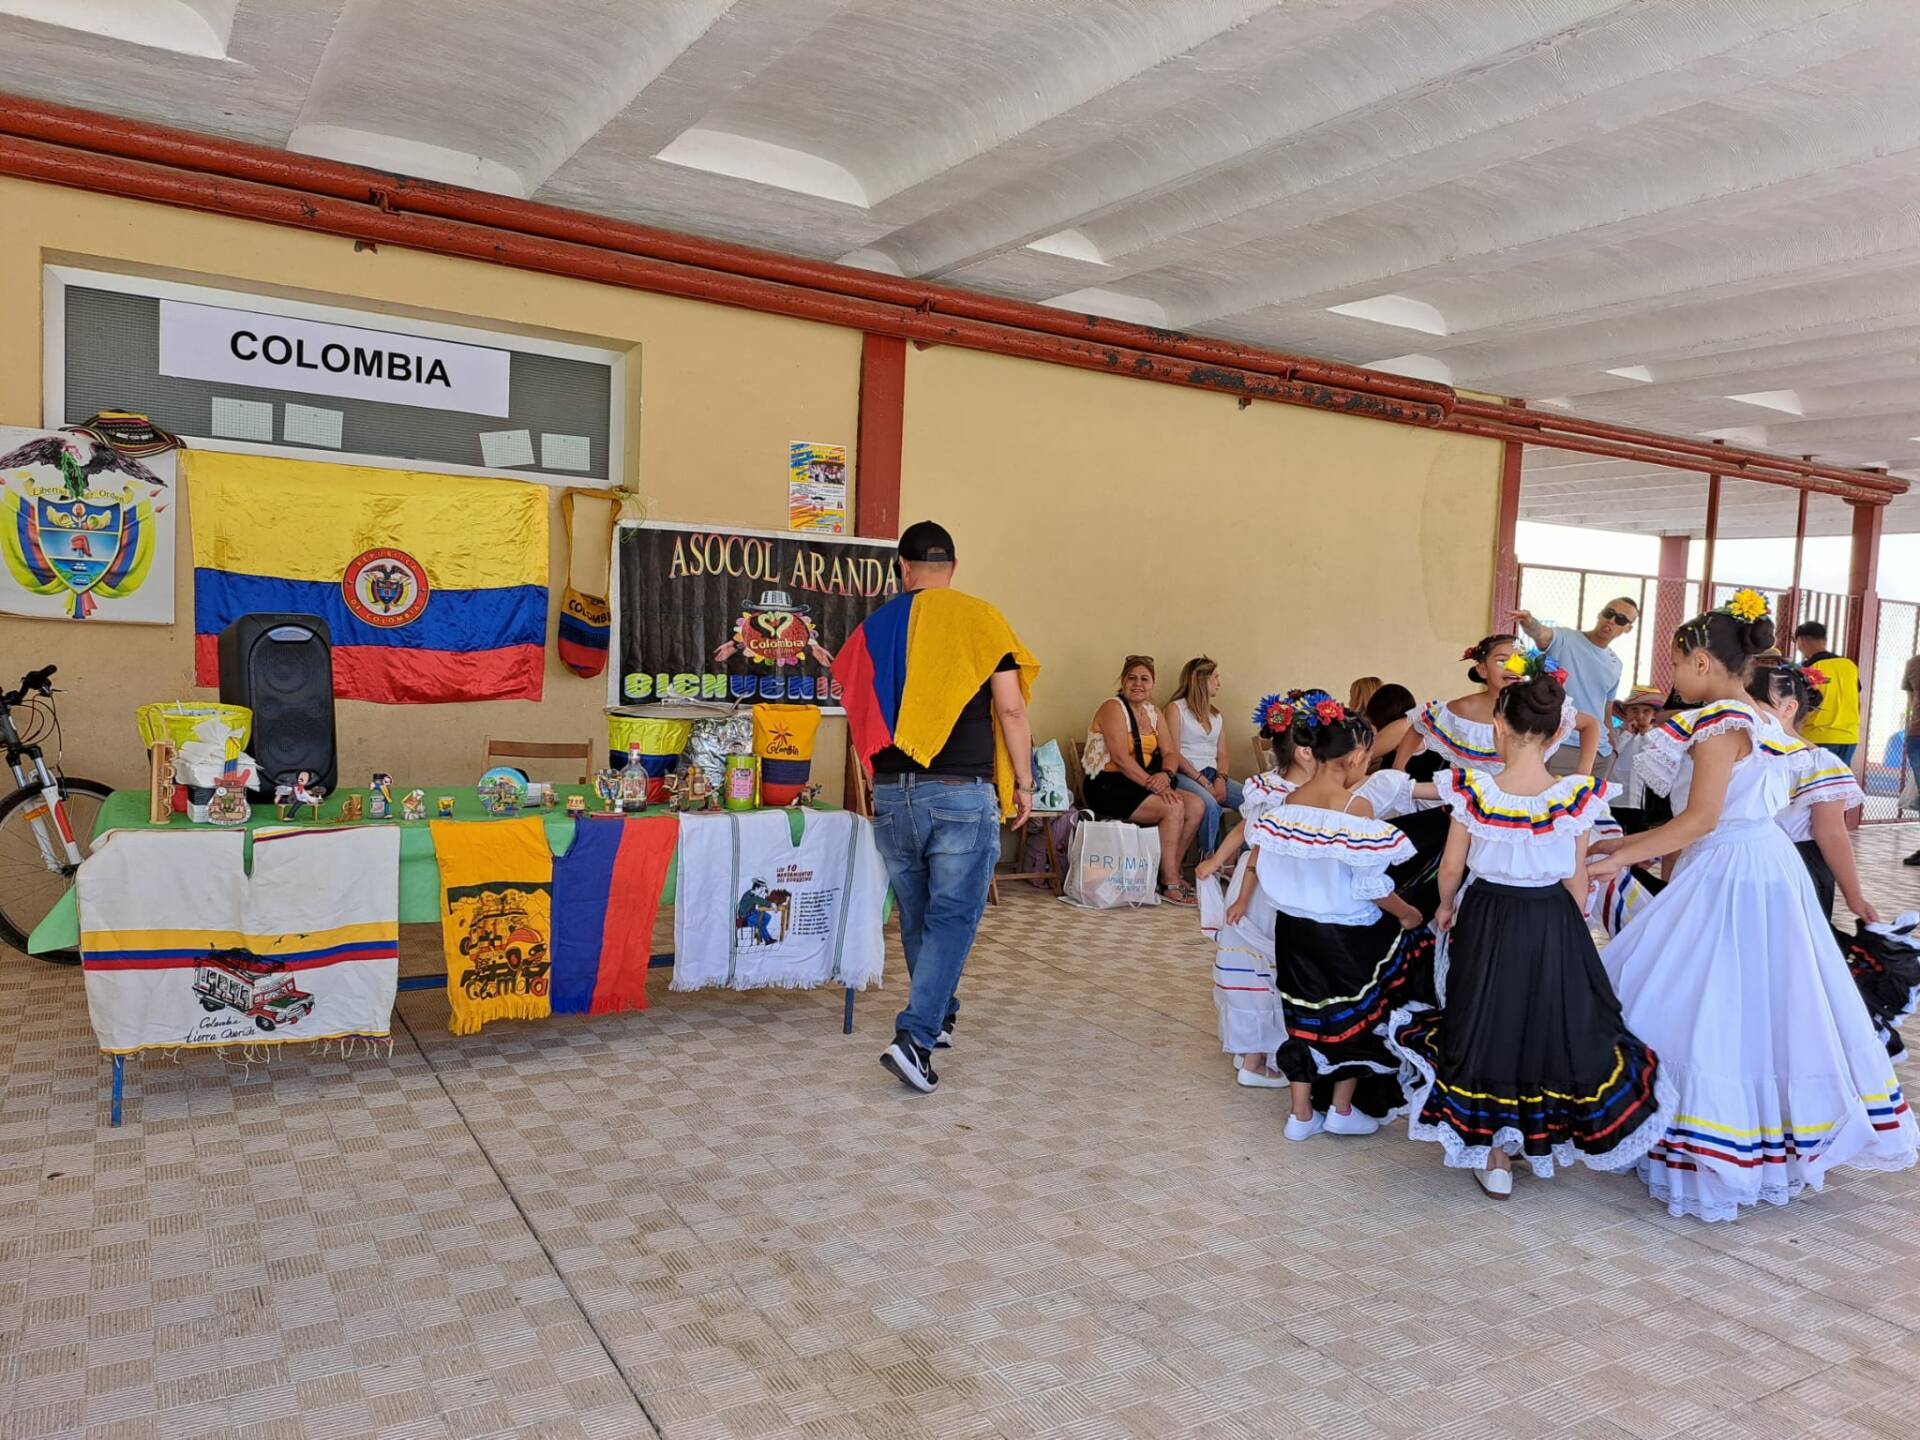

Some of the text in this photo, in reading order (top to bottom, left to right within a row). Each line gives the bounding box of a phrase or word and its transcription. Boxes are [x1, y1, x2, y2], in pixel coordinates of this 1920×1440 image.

[230, 330, 452, 388] COLOMBIA
[668, 532, 898, 598] ASOCOL ARANDA
[750, 638, 805, 649] Colombia
[787, 863, 797, 872] 10
[1089, 854, 1155, 870] PRIMA
[199, 1015, 242, 1030] Colombia
